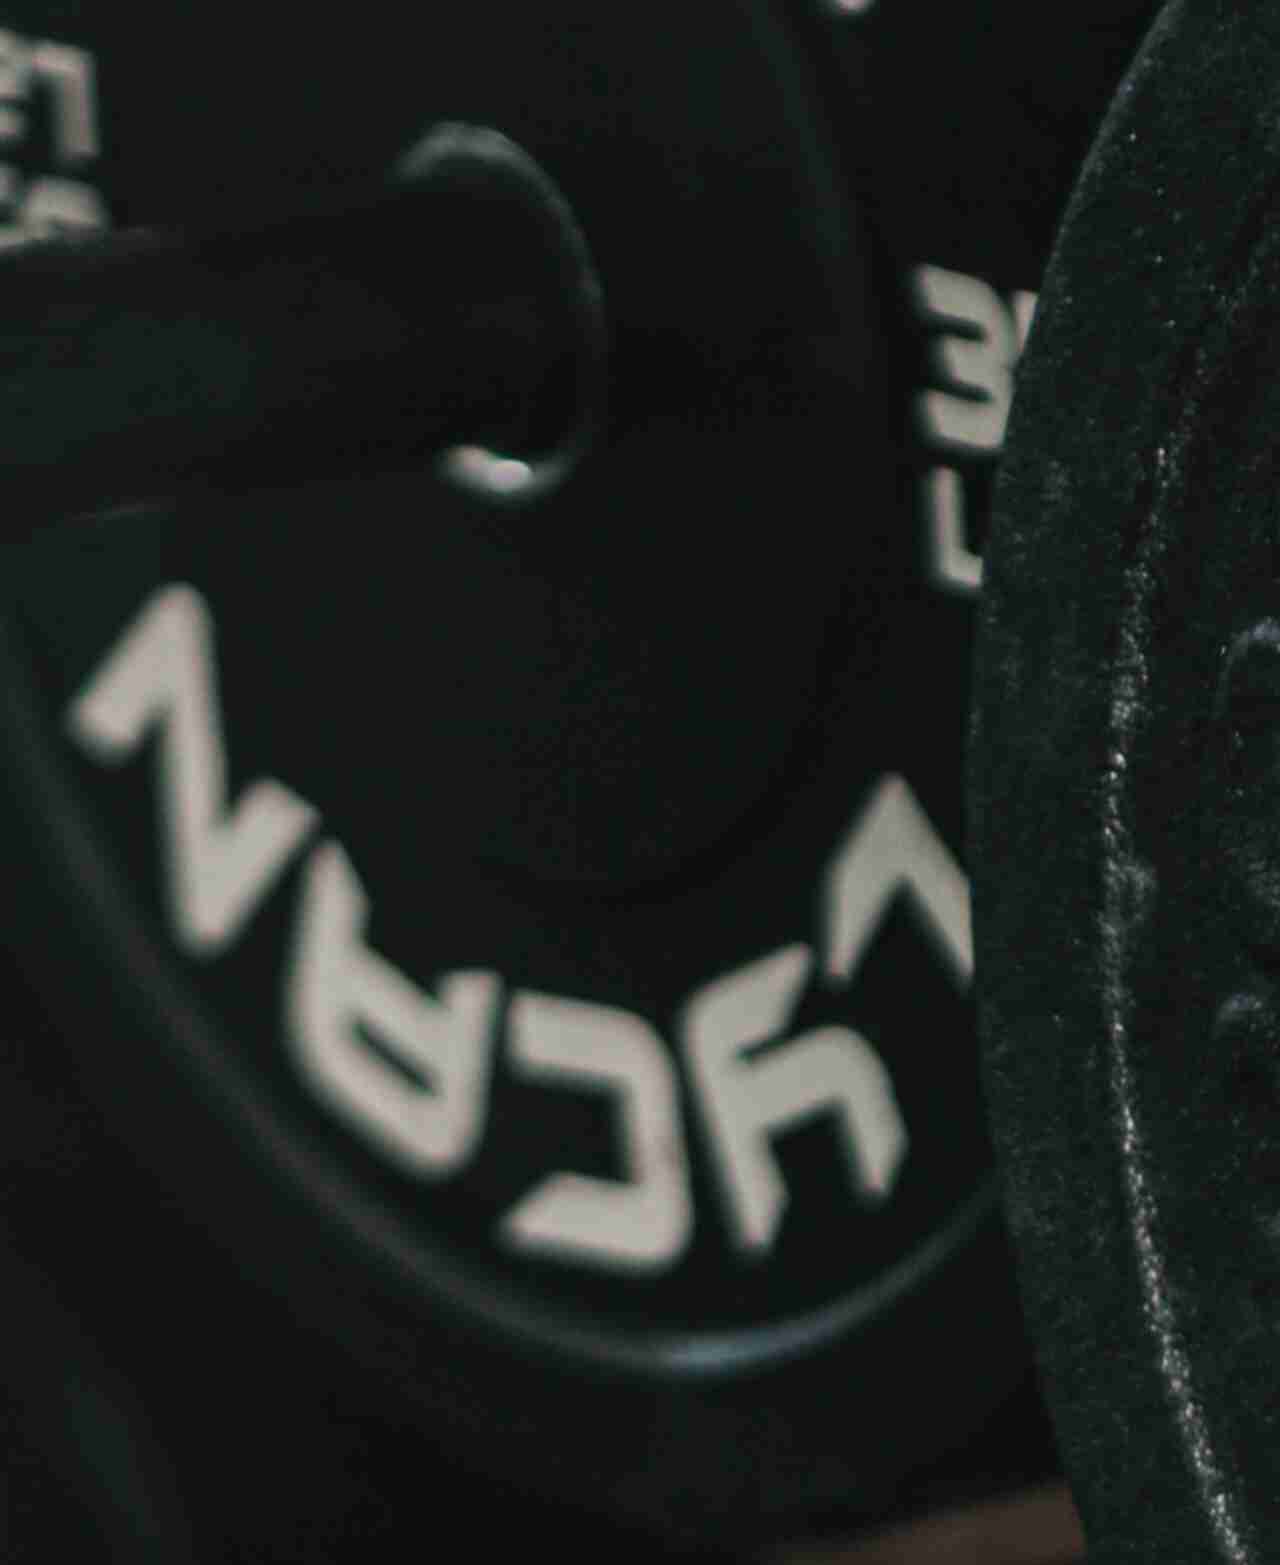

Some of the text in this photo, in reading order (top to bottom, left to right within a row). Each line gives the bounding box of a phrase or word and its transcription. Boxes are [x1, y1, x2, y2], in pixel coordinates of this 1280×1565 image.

[913, 258, 1040, 455] 3
[928, 462, 985, 592] L
[64, 580, 975, 1278] LYCAN
